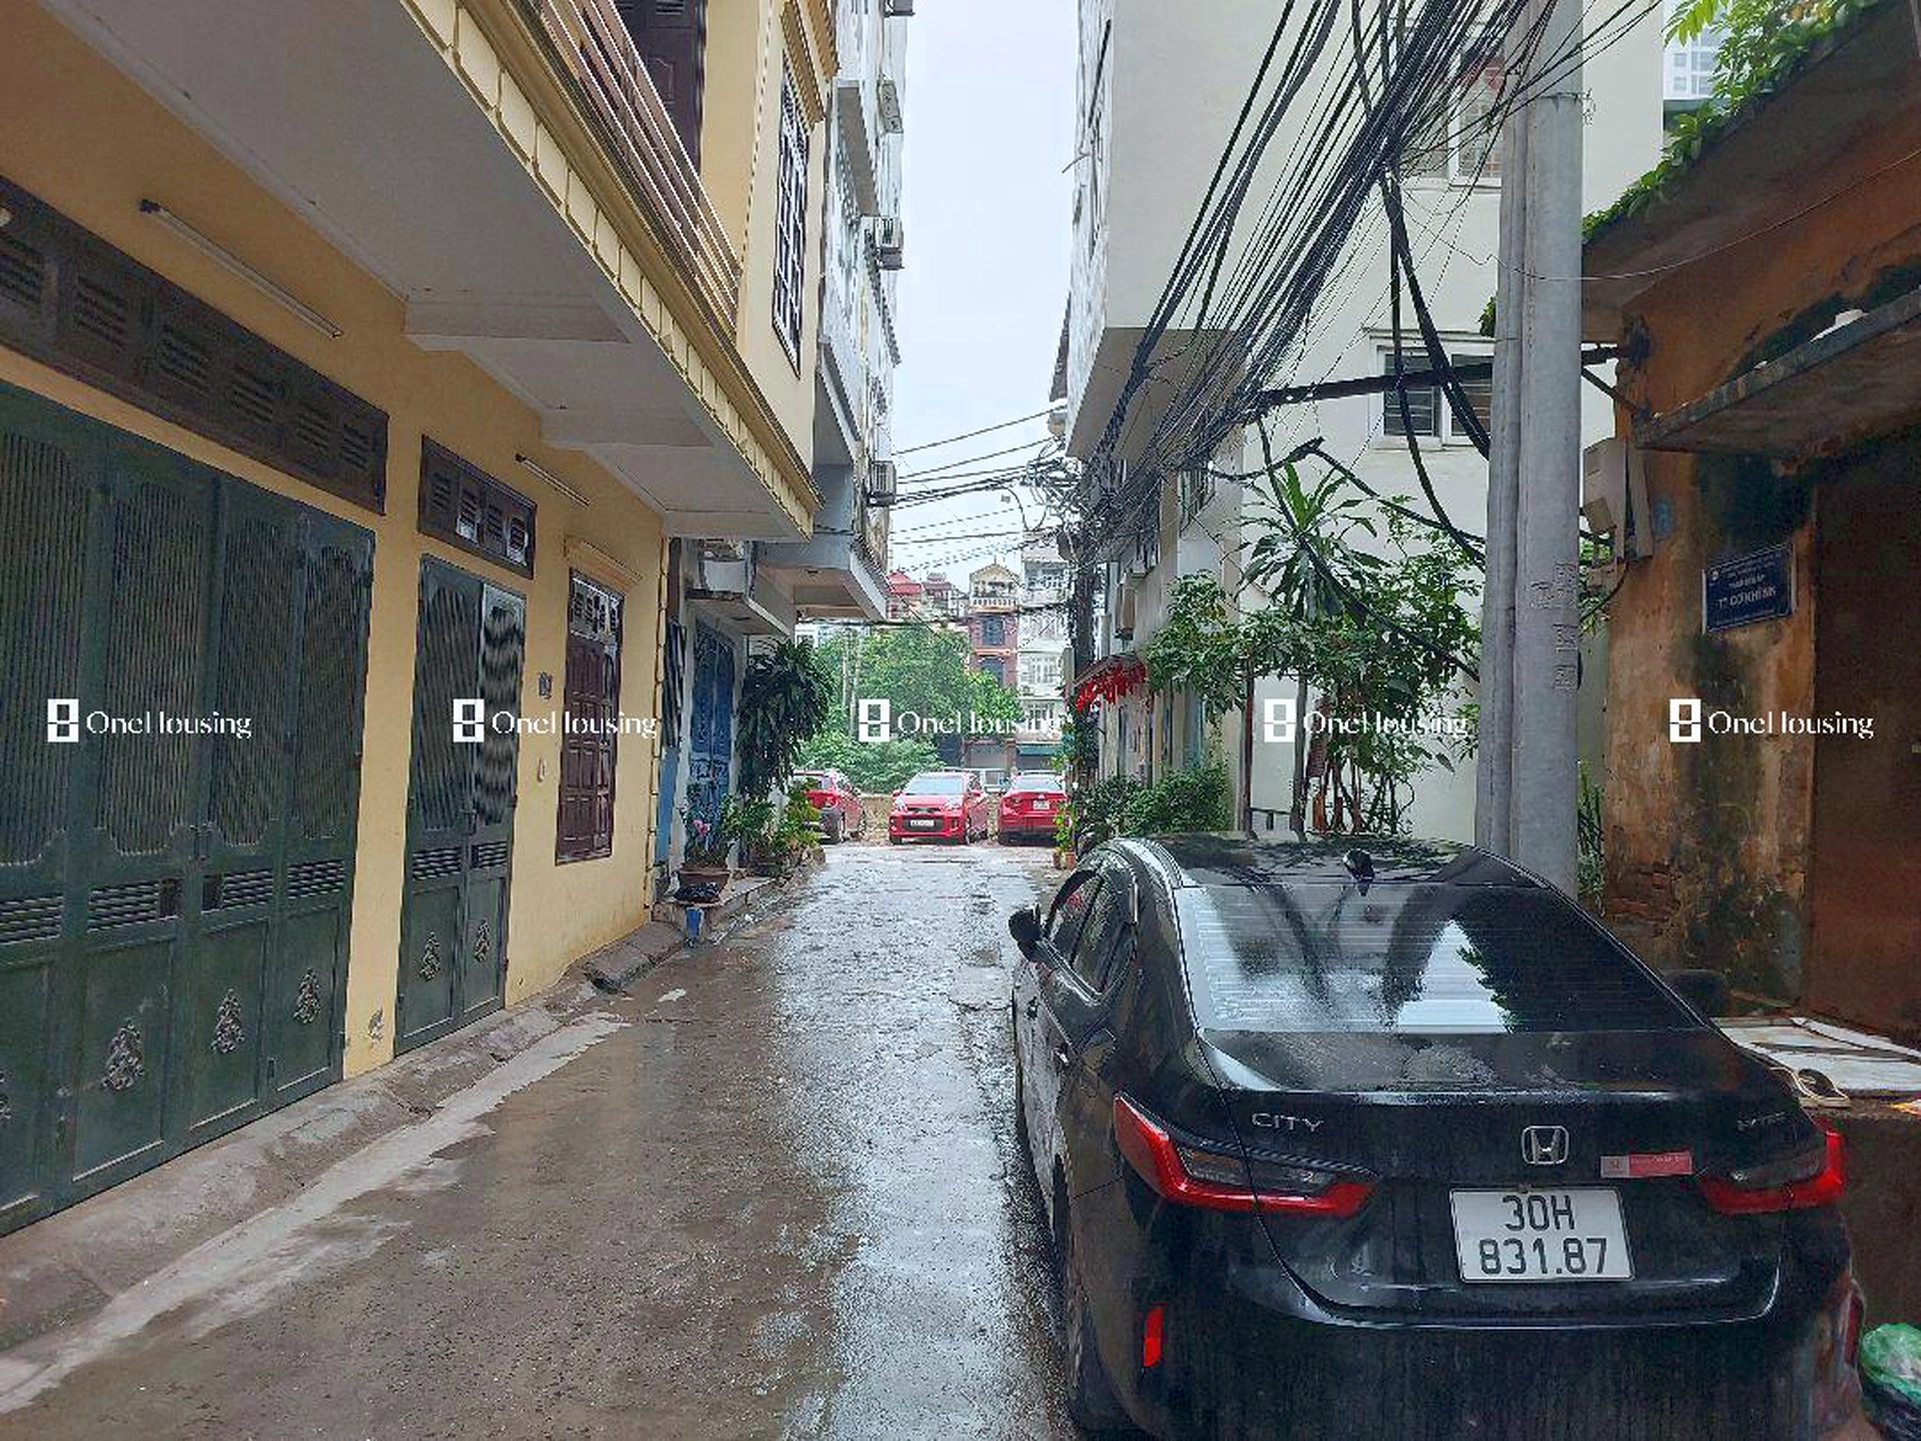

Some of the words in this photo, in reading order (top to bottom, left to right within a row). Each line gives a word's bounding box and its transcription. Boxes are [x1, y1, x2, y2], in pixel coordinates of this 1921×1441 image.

[1251, 1112, 1325, 1132] CITY
[1502, 1194, 1575, 1232] 30H
[1478, 1237, 1608, 1275] 831.87
